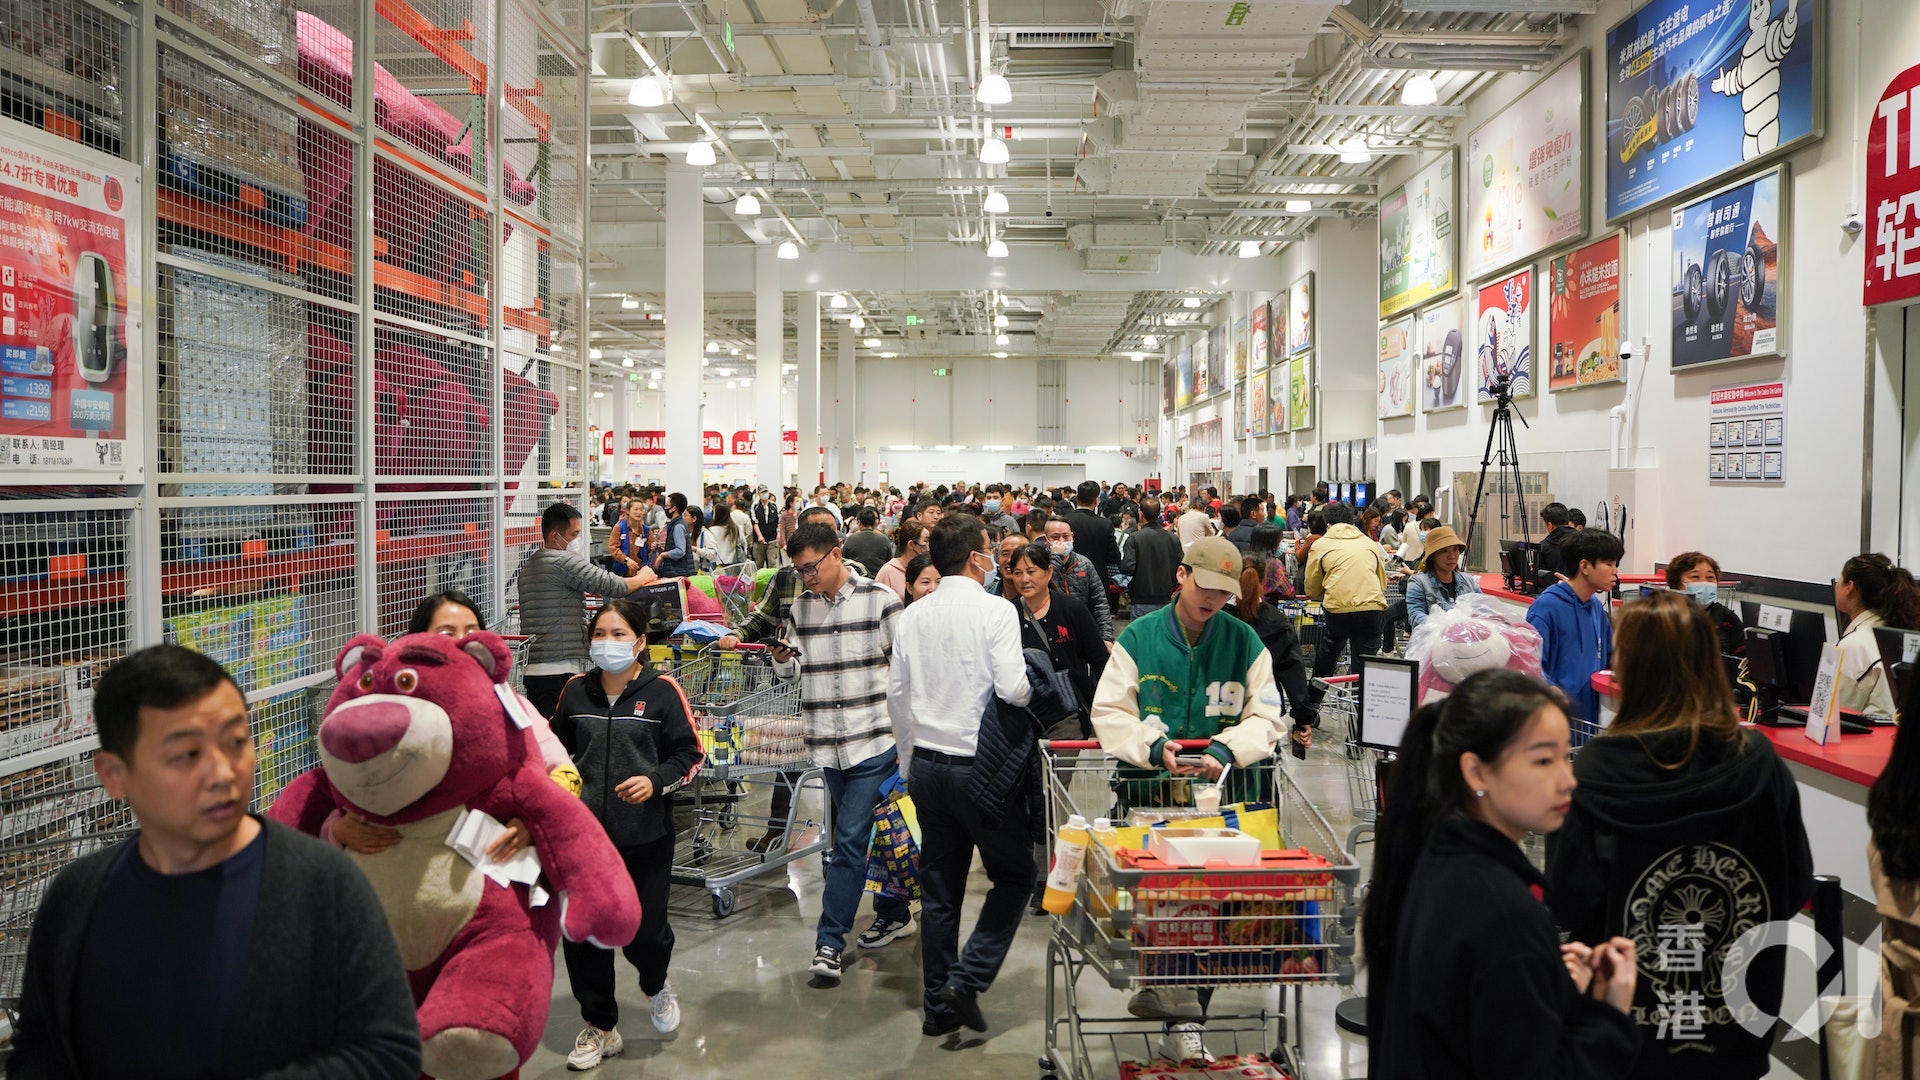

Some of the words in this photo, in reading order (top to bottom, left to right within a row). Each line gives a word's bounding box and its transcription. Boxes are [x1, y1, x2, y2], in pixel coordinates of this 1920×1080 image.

[1619, 28, 1655, 65] 米其林轮胎
[1528, 129, 1572, 171] 增强免疫力
[1707, 201, 1741, 228] 普利司通
[1205, 680, 1246, 718] 19
